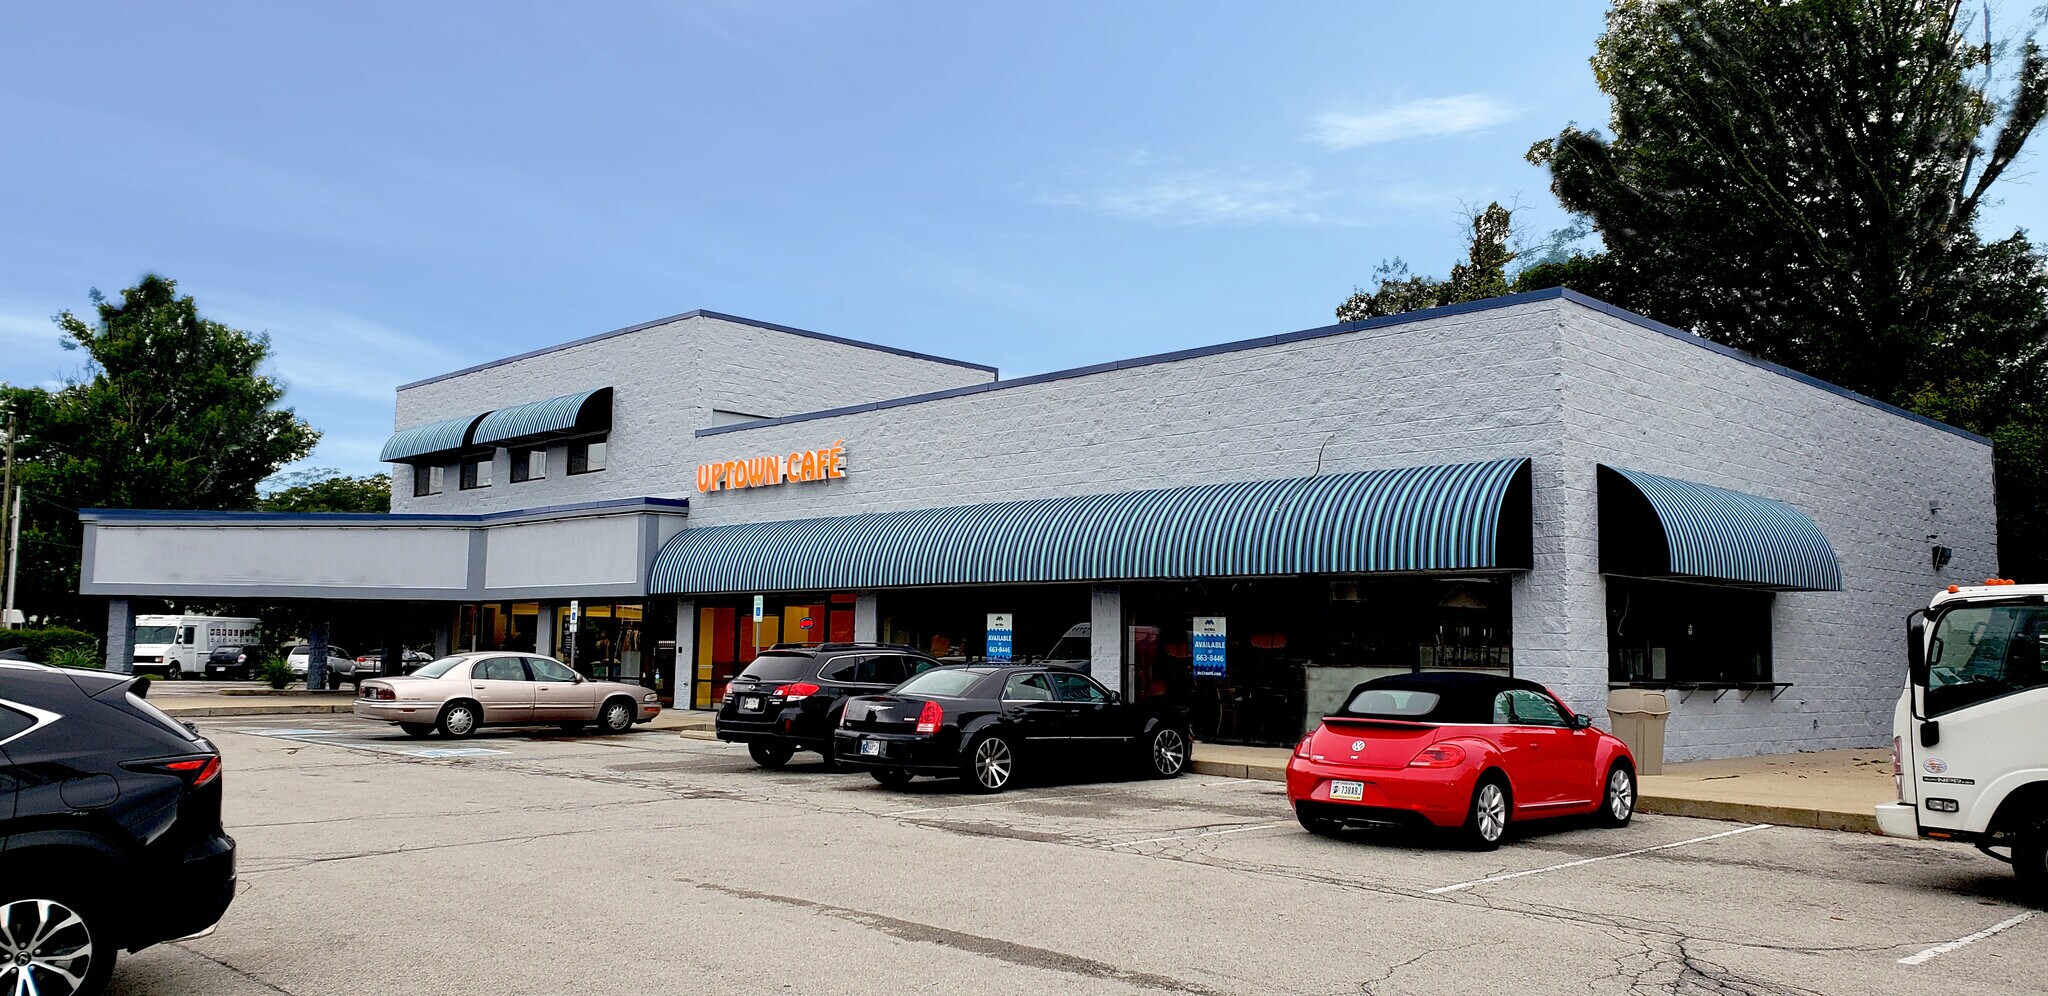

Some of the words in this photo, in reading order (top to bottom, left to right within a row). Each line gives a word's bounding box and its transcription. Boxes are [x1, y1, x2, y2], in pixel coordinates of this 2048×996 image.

[697, 455, 781, 493] UPTOWN
[786, 439, 844, 483] CAFÉ
[1195, 641, 1225, 649] AVAILABLE
[1196, 654, 1224, 662] 663-8446
